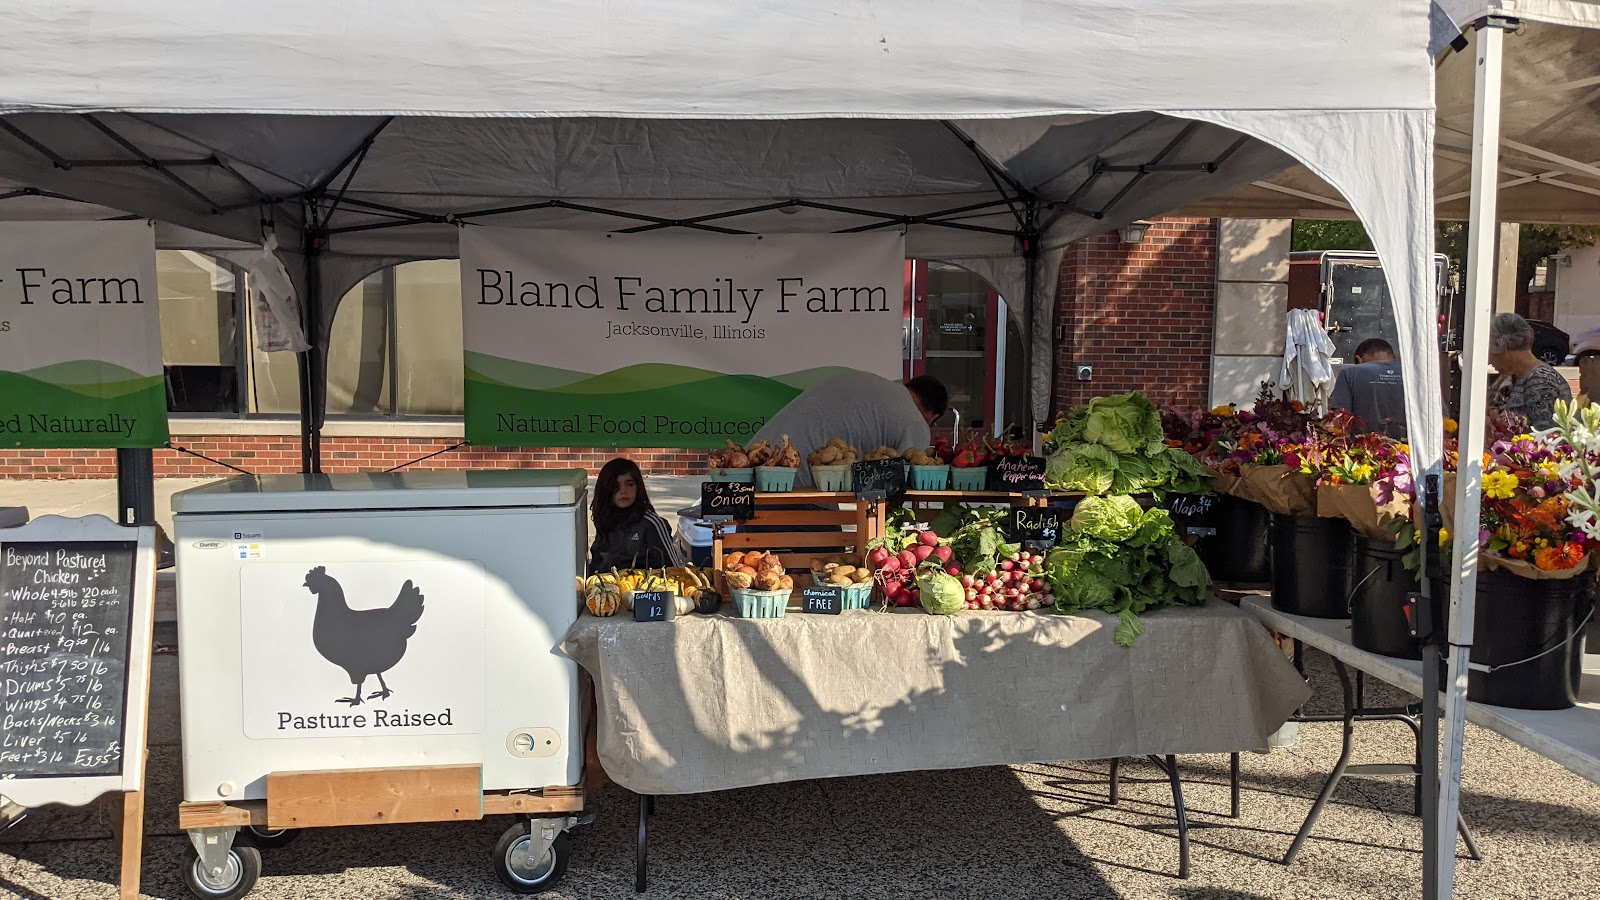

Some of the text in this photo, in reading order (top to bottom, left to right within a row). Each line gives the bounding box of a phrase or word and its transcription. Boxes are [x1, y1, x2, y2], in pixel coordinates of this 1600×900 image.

[15, 268, 144, 305] Farm
[476, 268, 890, 324] Bland Family Farm
[605, 320, 766, 341] Jacksonville, Illinois
[30, 413, 136, 438] Naturally
[496, 413, 582, 434] Natural
[588, 414, 648, 435] Food
[996, 456, 1038, 472] Anaheim
[859, 470, 893, 485] Potato
[1003, 470, 1029, 483] Pepper
[711, 493, 750, 508] Onion
[1171, 495, 1212, 517] Napa $4
[1016, 510, 1059, 530] Radish
[1042, 527, 1057, 541] $3
[7, 547, 106, 571] Beyond Pastured
[34, 568, 79, 584] Chicken
[11, 586, 50, 601] Whole
[82, 587, 99, 599] $20
[635, 592, 661, 602] Gourds
[81, 598, 97, 608] $25
[809, 598, 832, 610] FREE
[10, 611, 37, 626] Half
[44, 609, 66, 625] $10
[650, 606, 663, 618] $2
[8, 625, 65, 639] Quartered
[72, 619, 99, 637] $12
[7, 642, 51, 656] Breast
[4, 659, 49, 676] Thighs
[6, 678, 54, 697] Drums
[5, 698, 51, 713] Wings
[3, 713, 83, 733] Backs/Necks
[277, 708, 453, 730] Pasture Raised
[3, 733, 46, 748] Liver
[53, 729, 72, 744] $5
[0, 750, 32, 763] Feet
[34, 746, 48, 764] $3
[74, 748, 112, 768] Eggs
